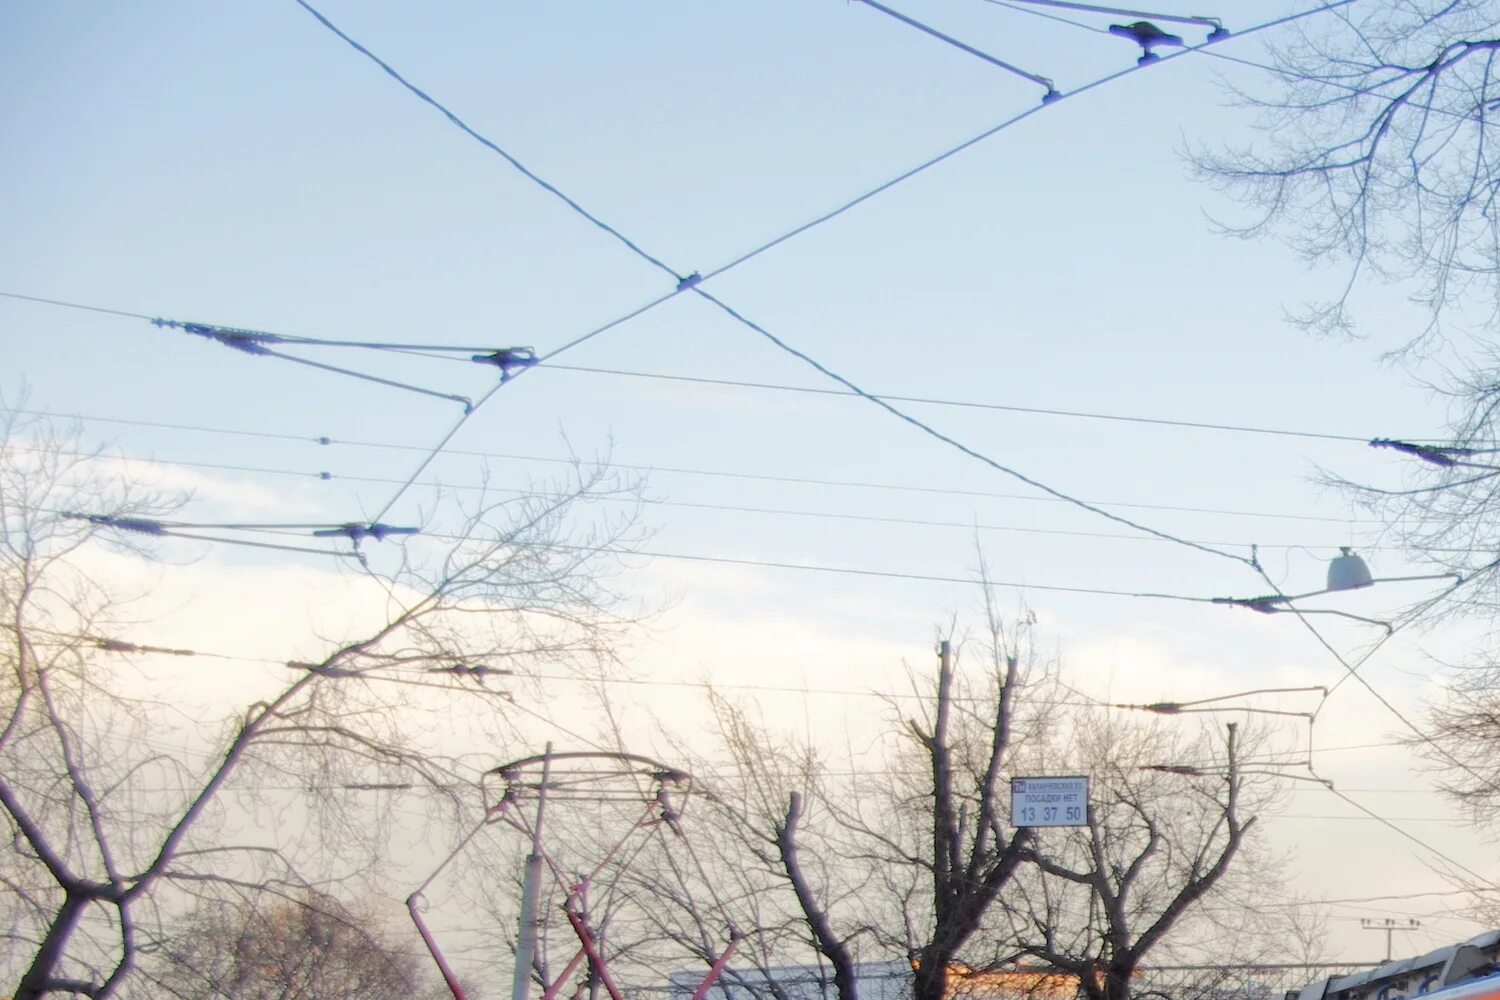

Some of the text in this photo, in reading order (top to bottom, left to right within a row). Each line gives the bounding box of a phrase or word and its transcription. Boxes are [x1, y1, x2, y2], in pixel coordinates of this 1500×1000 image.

[1025, 793, 1078, 803] ПОСАДКИ НЕТ
[1021, 806, 1081, 821] 13 37 50
